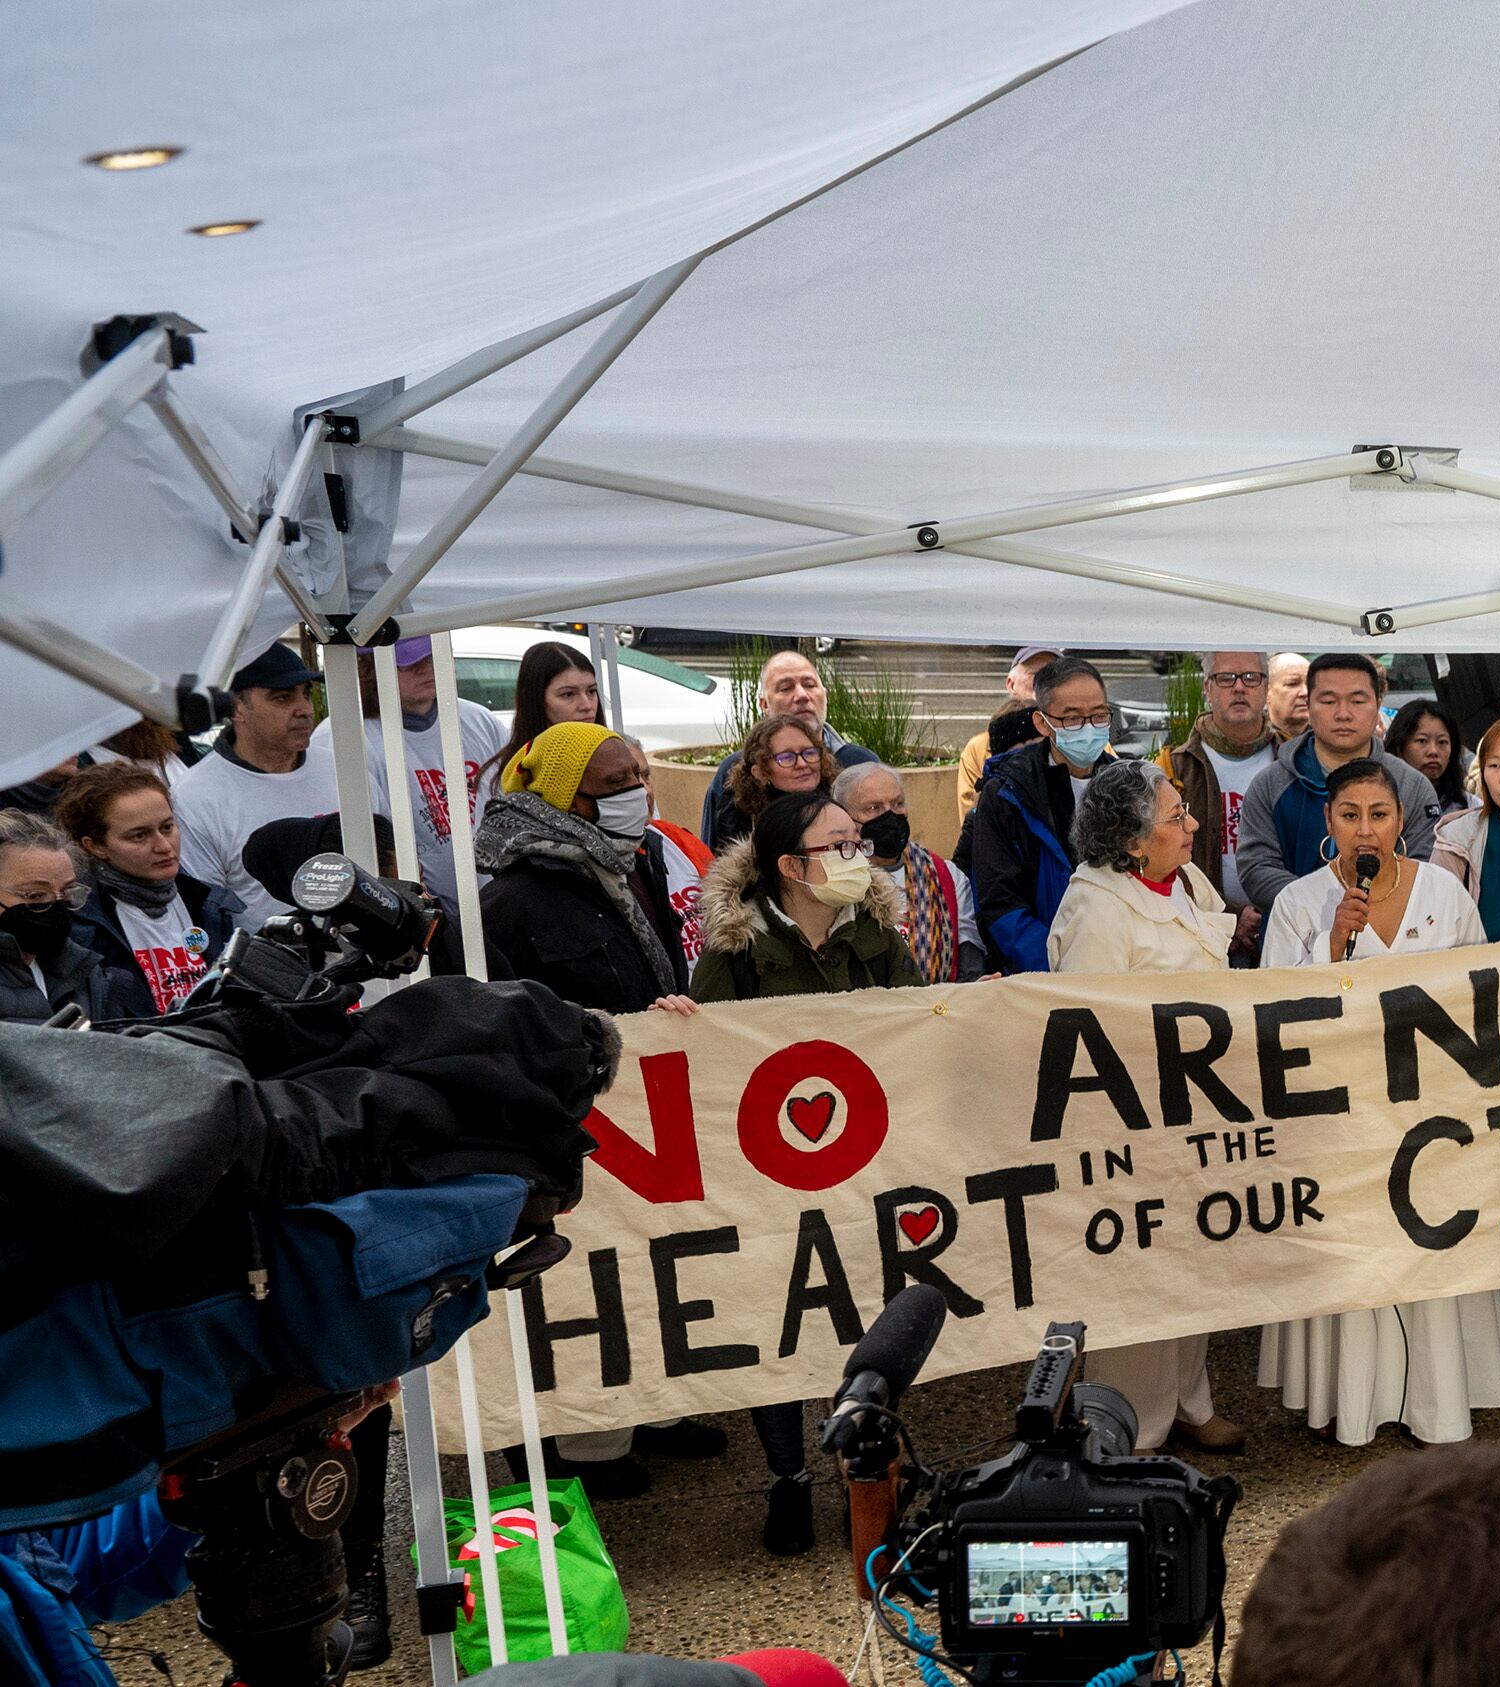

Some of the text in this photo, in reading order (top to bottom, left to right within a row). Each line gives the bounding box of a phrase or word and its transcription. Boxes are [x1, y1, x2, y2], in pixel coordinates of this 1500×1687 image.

[305, 872, 344, 883] ProLight
[312, 861, 343, 871] Frezzi
[566, 1039, 889, 1208] NO
[1080, 1126, 1277, 1186] IN THE
[530, 1163, 1060, 1392] HEART
[1085, 1198, 1165, 1255] OF
[1197, 1177, 1325, 1241] OUR
